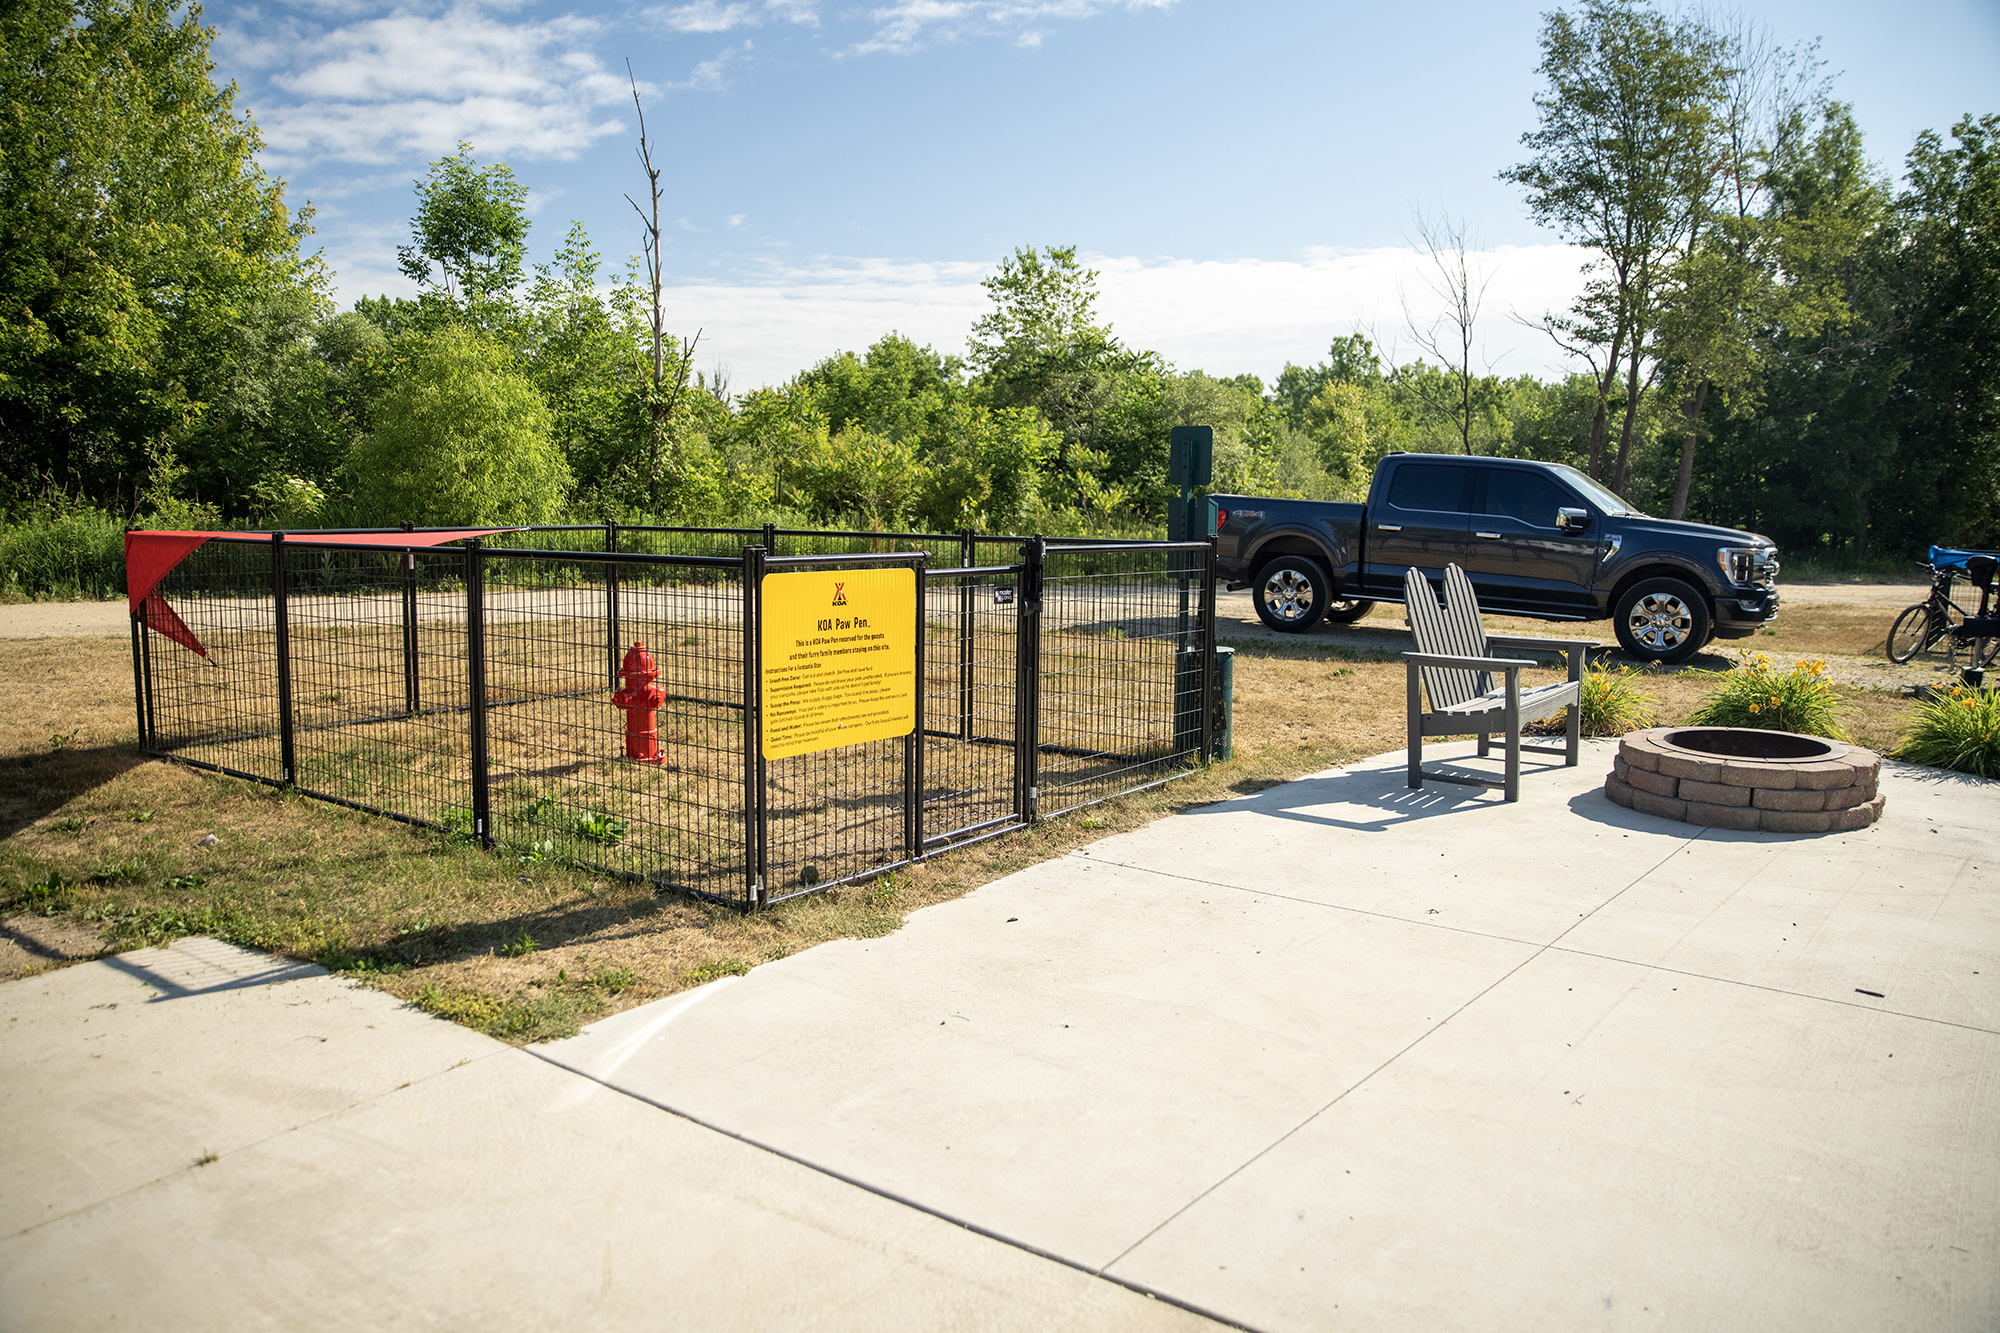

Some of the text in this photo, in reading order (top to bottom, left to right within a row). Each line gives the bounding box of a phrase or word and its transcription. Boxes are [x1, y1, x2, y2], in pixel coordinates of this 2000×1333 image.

[818, 619, 832, 632] KOA
[836, 618, 851, 630] Paw
[872, 632, 884, 640] guests
[809, 651, 819, 659] furry
[820, 649, 832, 658] family
[852, 646, 867, 654] staying
